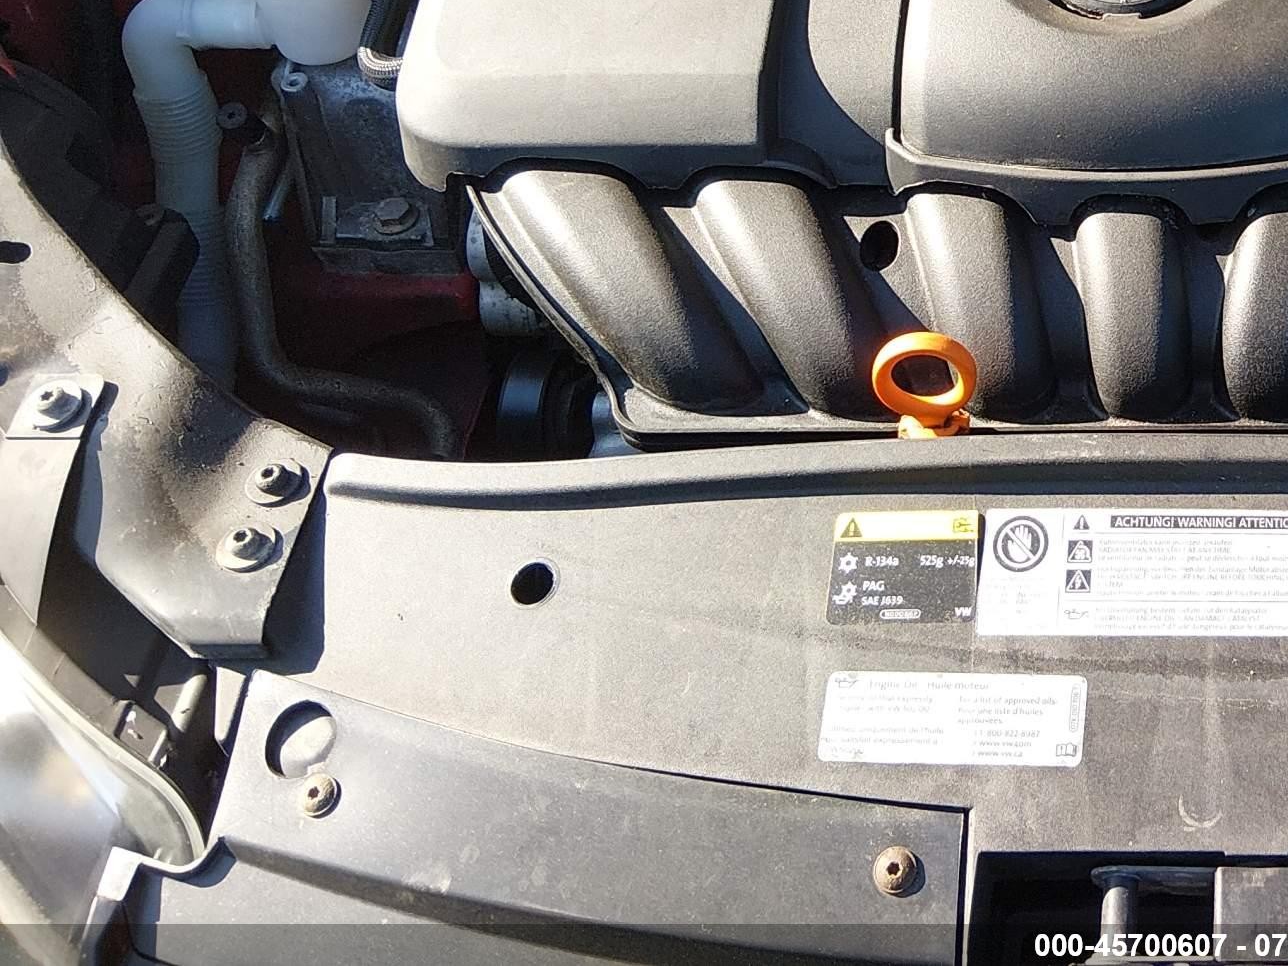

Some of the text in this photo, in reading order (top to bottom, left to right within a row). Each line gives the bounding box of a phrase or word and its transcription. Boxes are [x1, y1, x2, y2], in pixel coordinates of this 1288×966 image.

[1114, 515, 1175, 528] ACHTUNG!
[1178, 516, 1236, 528] WARNING!
[864, 555, 900, 567] R-134a
[920, 554, 943, 568] 525g
[862, 580, 885, 591] PAG
[861, 596, 880, 606] SAE
[954, 607, 972, 616] VW
[1004, 696, 1040, 706] approved
